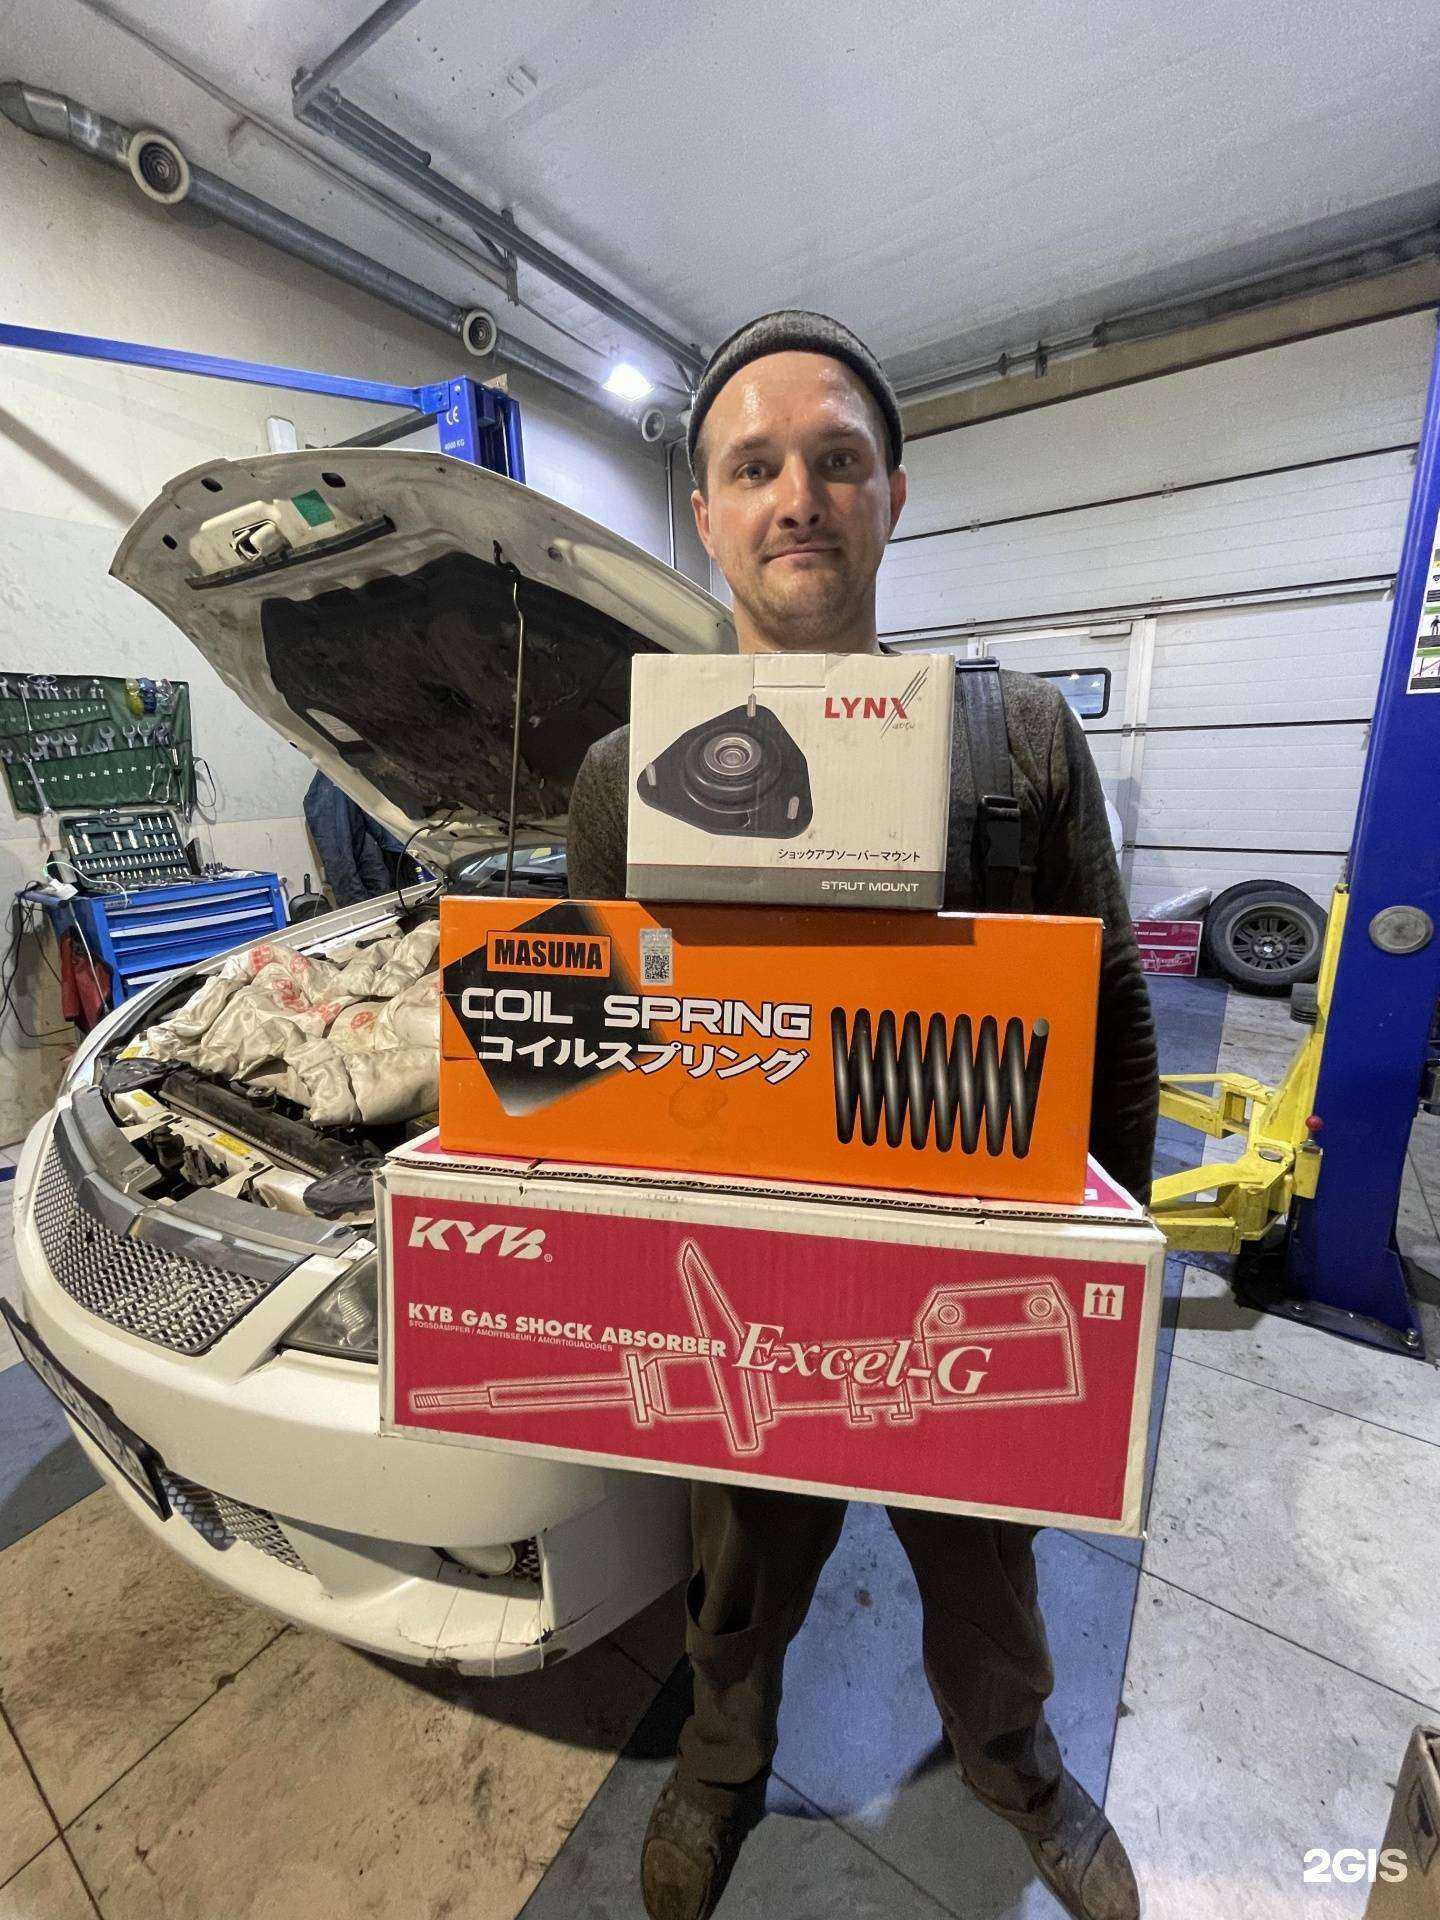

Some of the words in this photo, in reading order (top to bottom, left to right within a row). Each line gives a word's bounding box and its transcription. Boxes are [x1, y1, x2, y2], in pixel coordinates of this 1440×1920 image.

[824, 697, 908, 720] LYNX
[821, 880, 866, 892] STRUT
[868, 882, 919, 893] MOUNT
[494, 938, 603, 970] MASUMA
[461, 987, 574, 1025] COIL
[603, 994, 811, 1040] SPRING
[478, 1035, 809, 1084] コイルスプリング
[408, 1302, 453, 1323] KYB
[461, 1309, 508, 1330] GAS
[515, 1316, 593, 1341] SHOCK
[600, 1326, 727, 1358] ABSORBER
[732, 1321, 992, 1394] Excel-G
